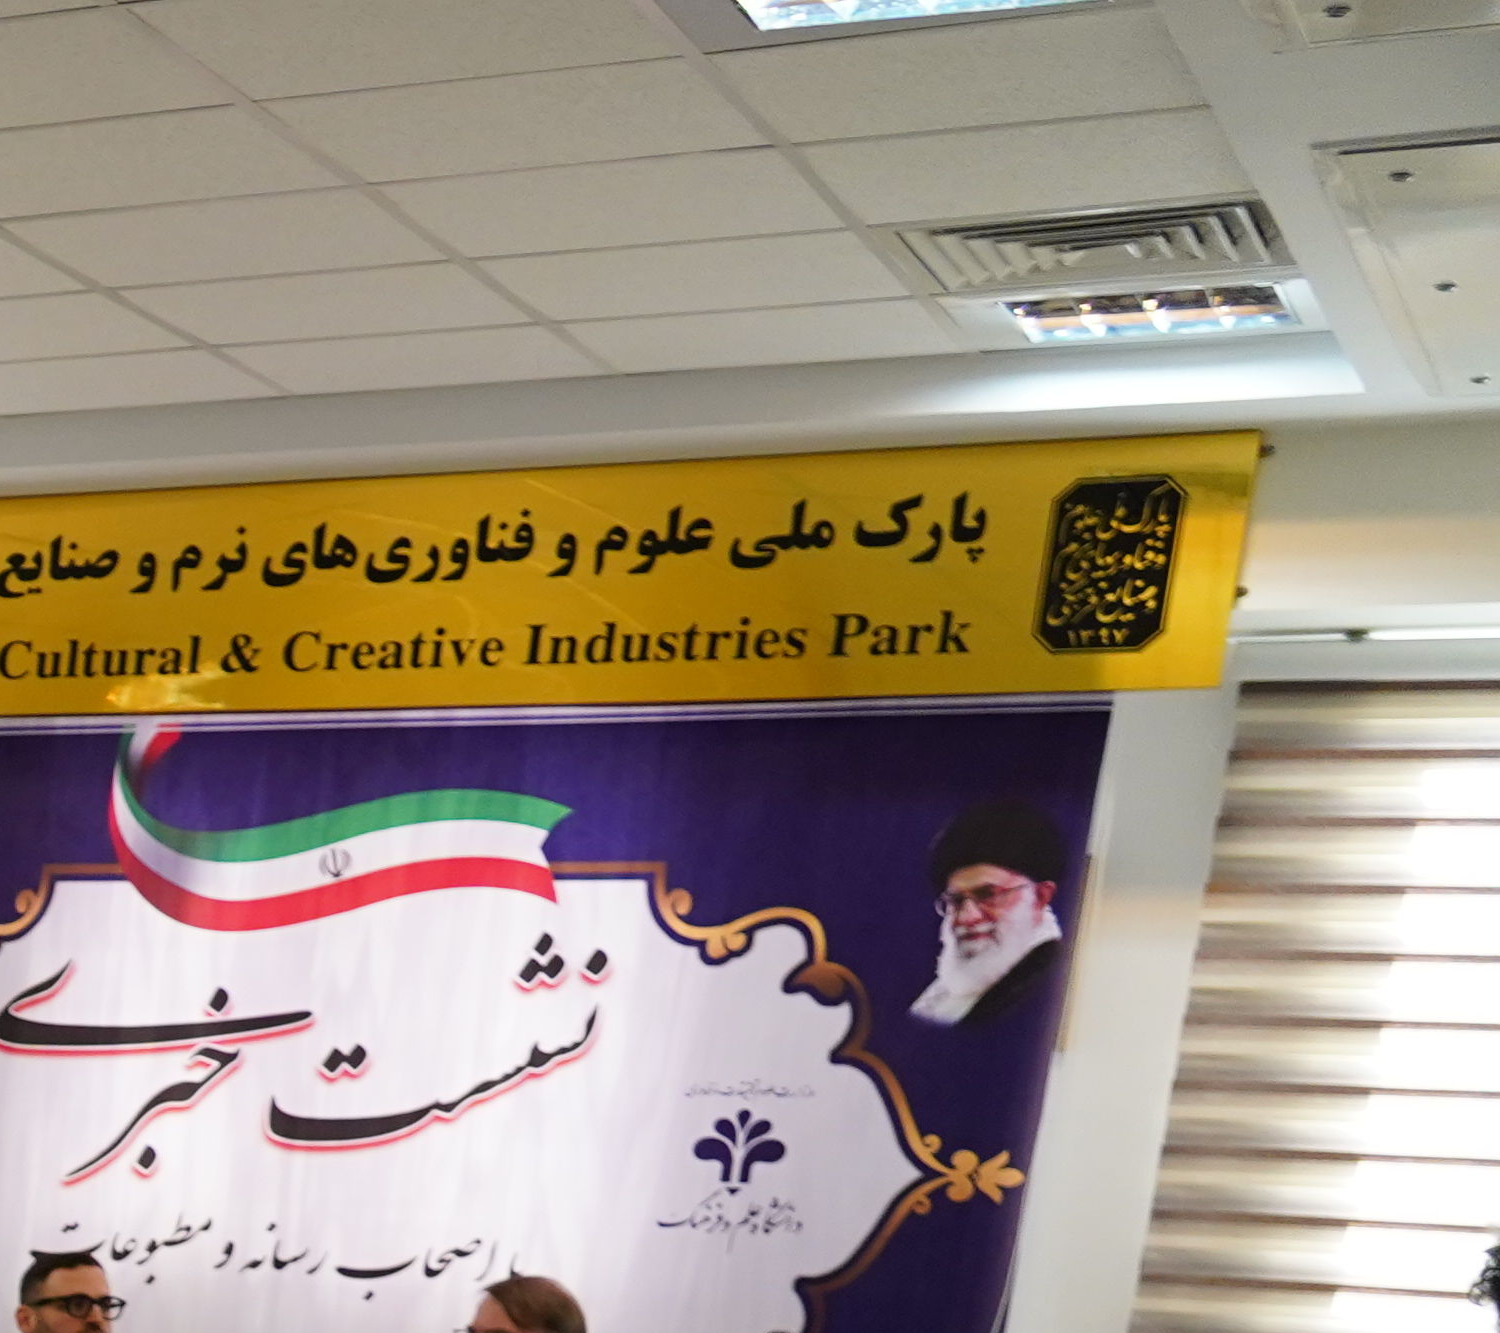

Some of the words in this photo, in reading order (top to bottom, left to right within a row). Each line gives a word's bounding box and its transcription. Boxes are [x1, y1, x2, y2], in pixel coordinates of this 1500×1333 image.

[170, 526, 249, 592] نرم
[546, 531, 578, 578] و
[594, 505, 714, 576] علوم
[729, 499, 836, 570] ملی
[853, 490, 988, 564] پارک
[129, 550, 158, 594] و
[219, 633, 261, 674] &
[282, 627, 505, 672] Creative
[523, 616, 809, 666] Industries
[826, 609, 971, 658] Park
[264, 932, 610, 1150] نشست
[29, 1213, 212, 1285] مطبوعات
[213, 1240, 236, 1270] و
[240, 1223, 326, 1276] رسانه
[336, 1237, 498, 1301] اصحاب
